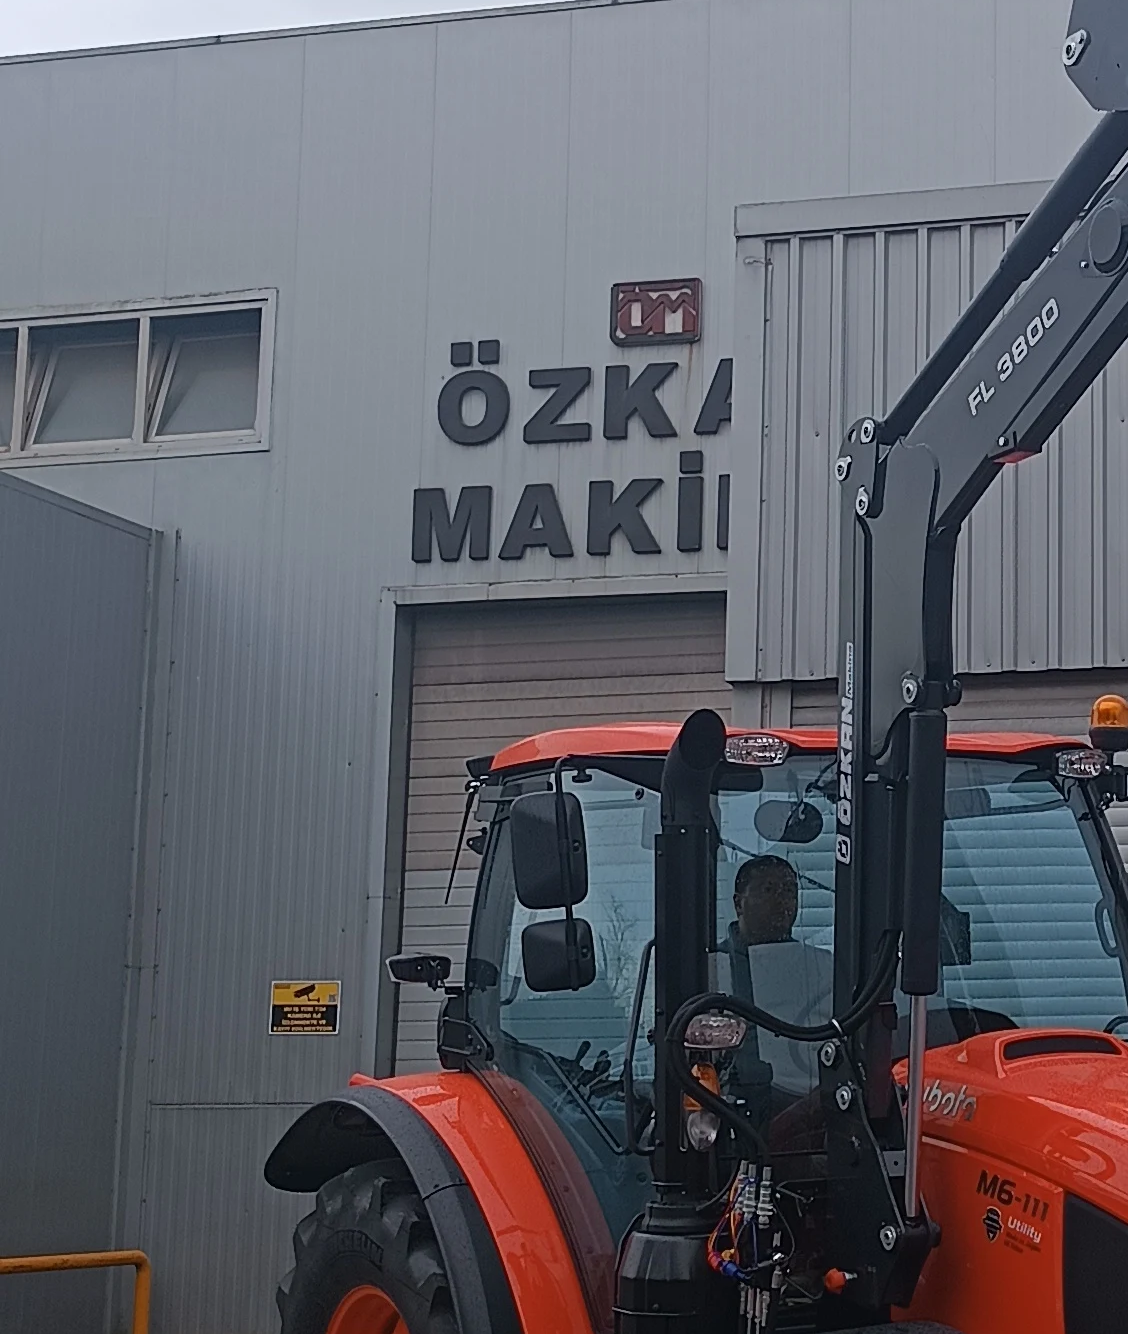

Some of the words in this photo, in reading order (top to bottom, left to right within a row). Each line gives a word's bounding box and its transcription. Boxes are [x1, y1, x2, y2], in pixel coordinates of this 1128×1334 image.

[967, 380, 996, 416] FL
[997, 297, 1060, 383] 3800
[976, 1169, 1050, 1223] M6-111
[1007, 1216, 1042, 1244] Utility
